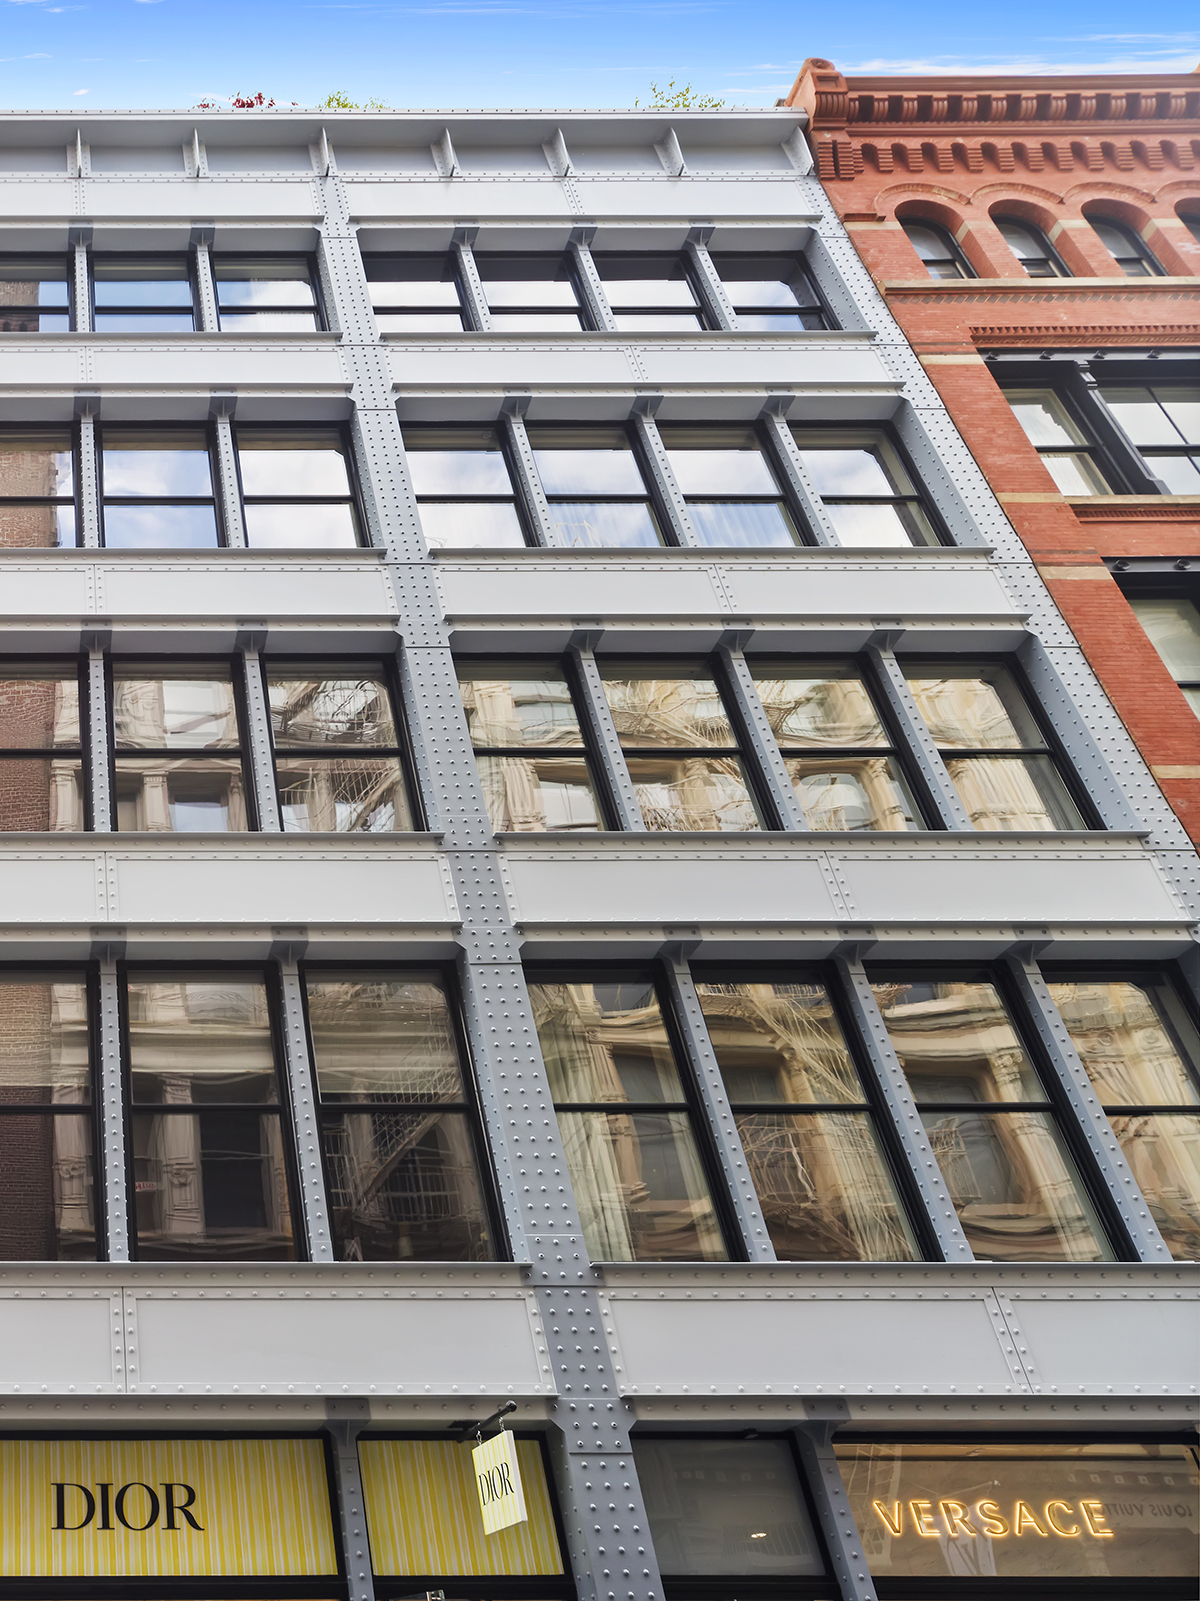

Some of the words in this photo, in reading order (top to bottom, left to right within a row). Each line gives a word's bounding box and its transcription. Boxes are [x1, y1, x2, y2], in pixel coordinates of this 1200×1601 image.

[478, 1462, 514, 1506] DIOR
[51, 1482, 205, 1531] DIOR
[873, 1500, 1114, 1536] VERSACE
